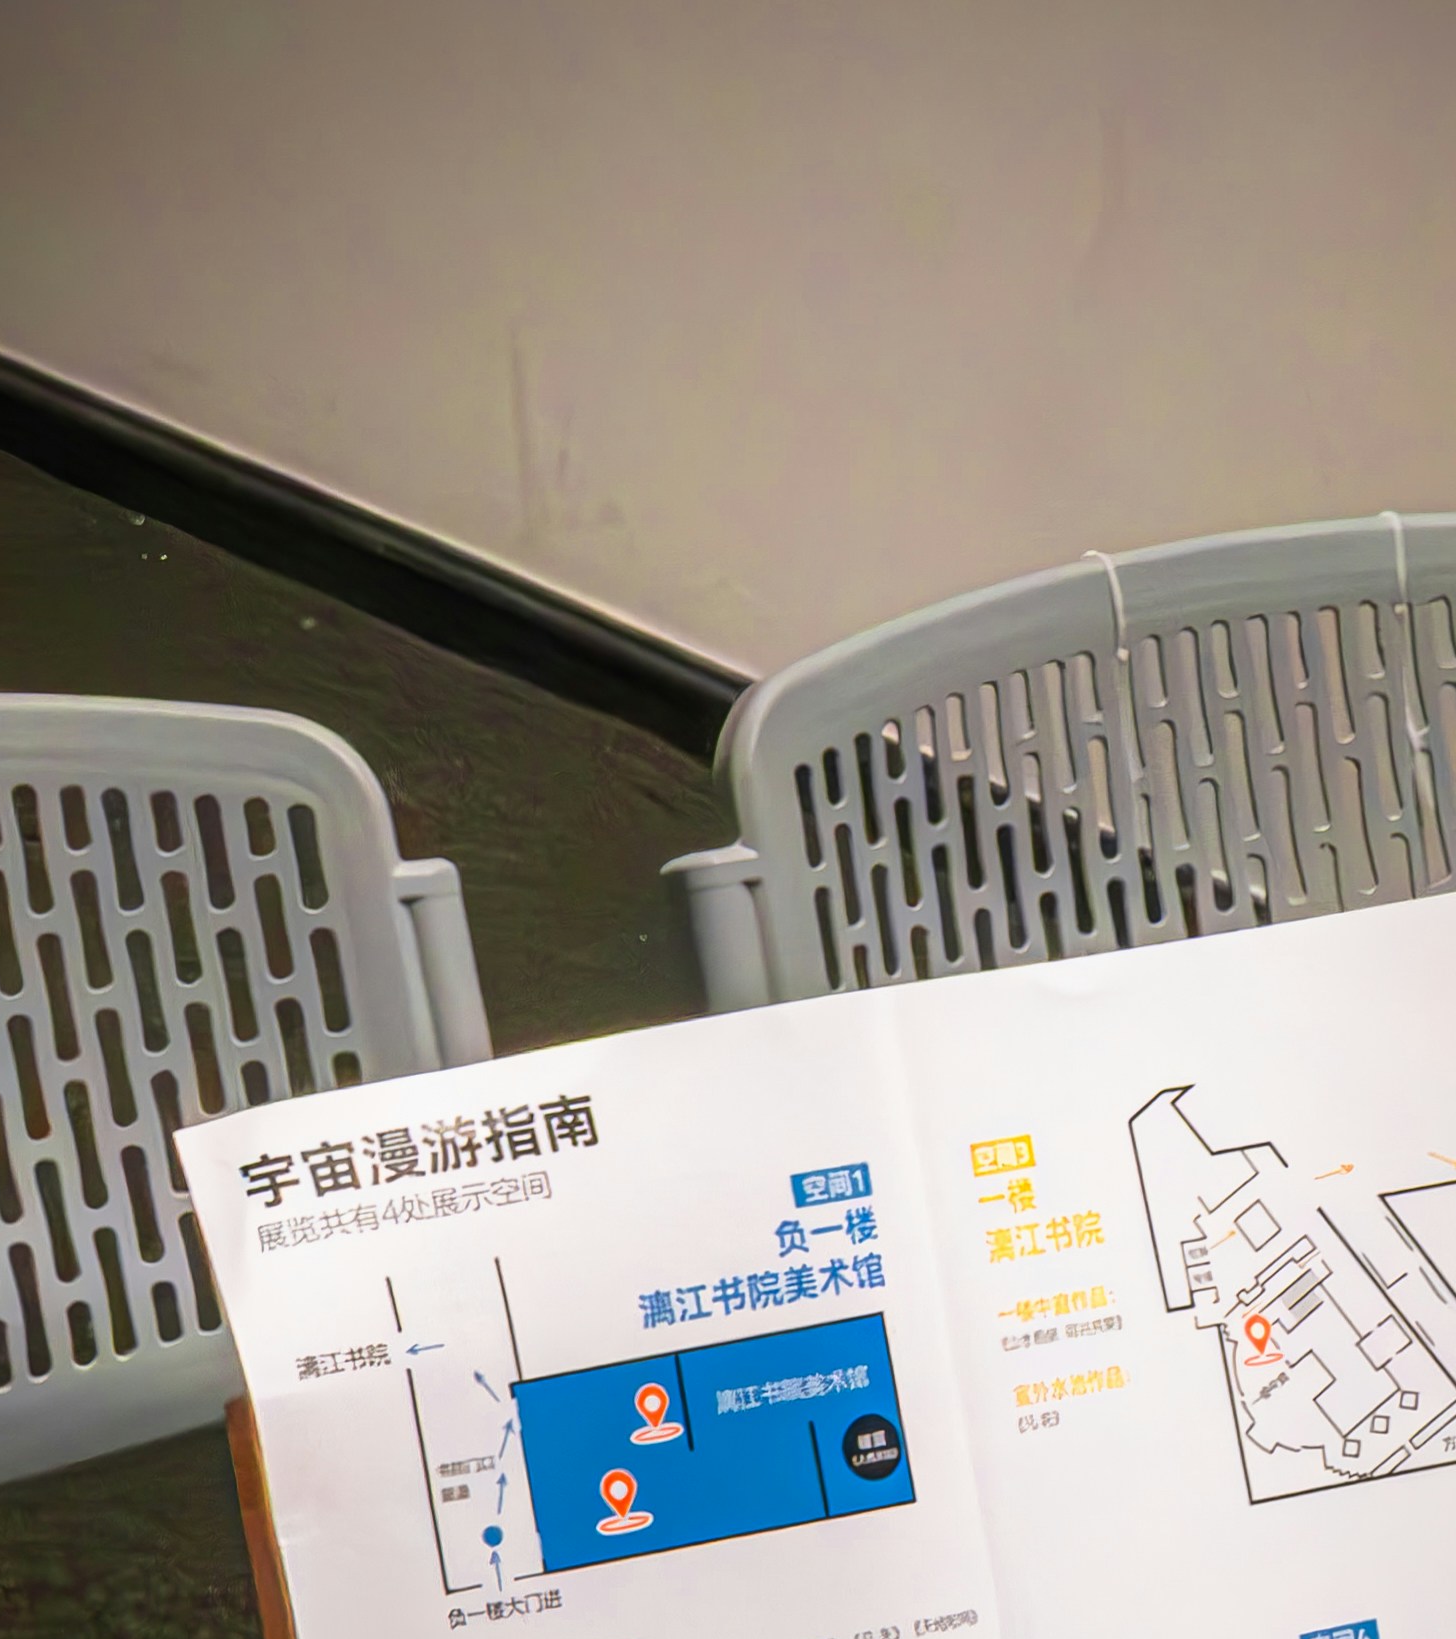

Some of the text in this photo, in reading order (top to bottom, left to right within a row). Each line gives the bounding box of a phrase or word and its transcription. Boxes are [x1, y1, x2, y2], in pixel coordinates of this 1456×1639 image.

[238, 1094, 599, 1208] 宇宙漫游指南
[257, 1171, 552, 1252] 展览共有4处展示空间
[802, 1169, 864, 1203] 空间1
[978, 1178, 1037, 1213] 一楼
[775, 1206, 879, 1257] 负一楼
[985, 1210, 1105, 1264] 漓江书院
[638, 1252, 886, 1329] 漓江书院美术馆
